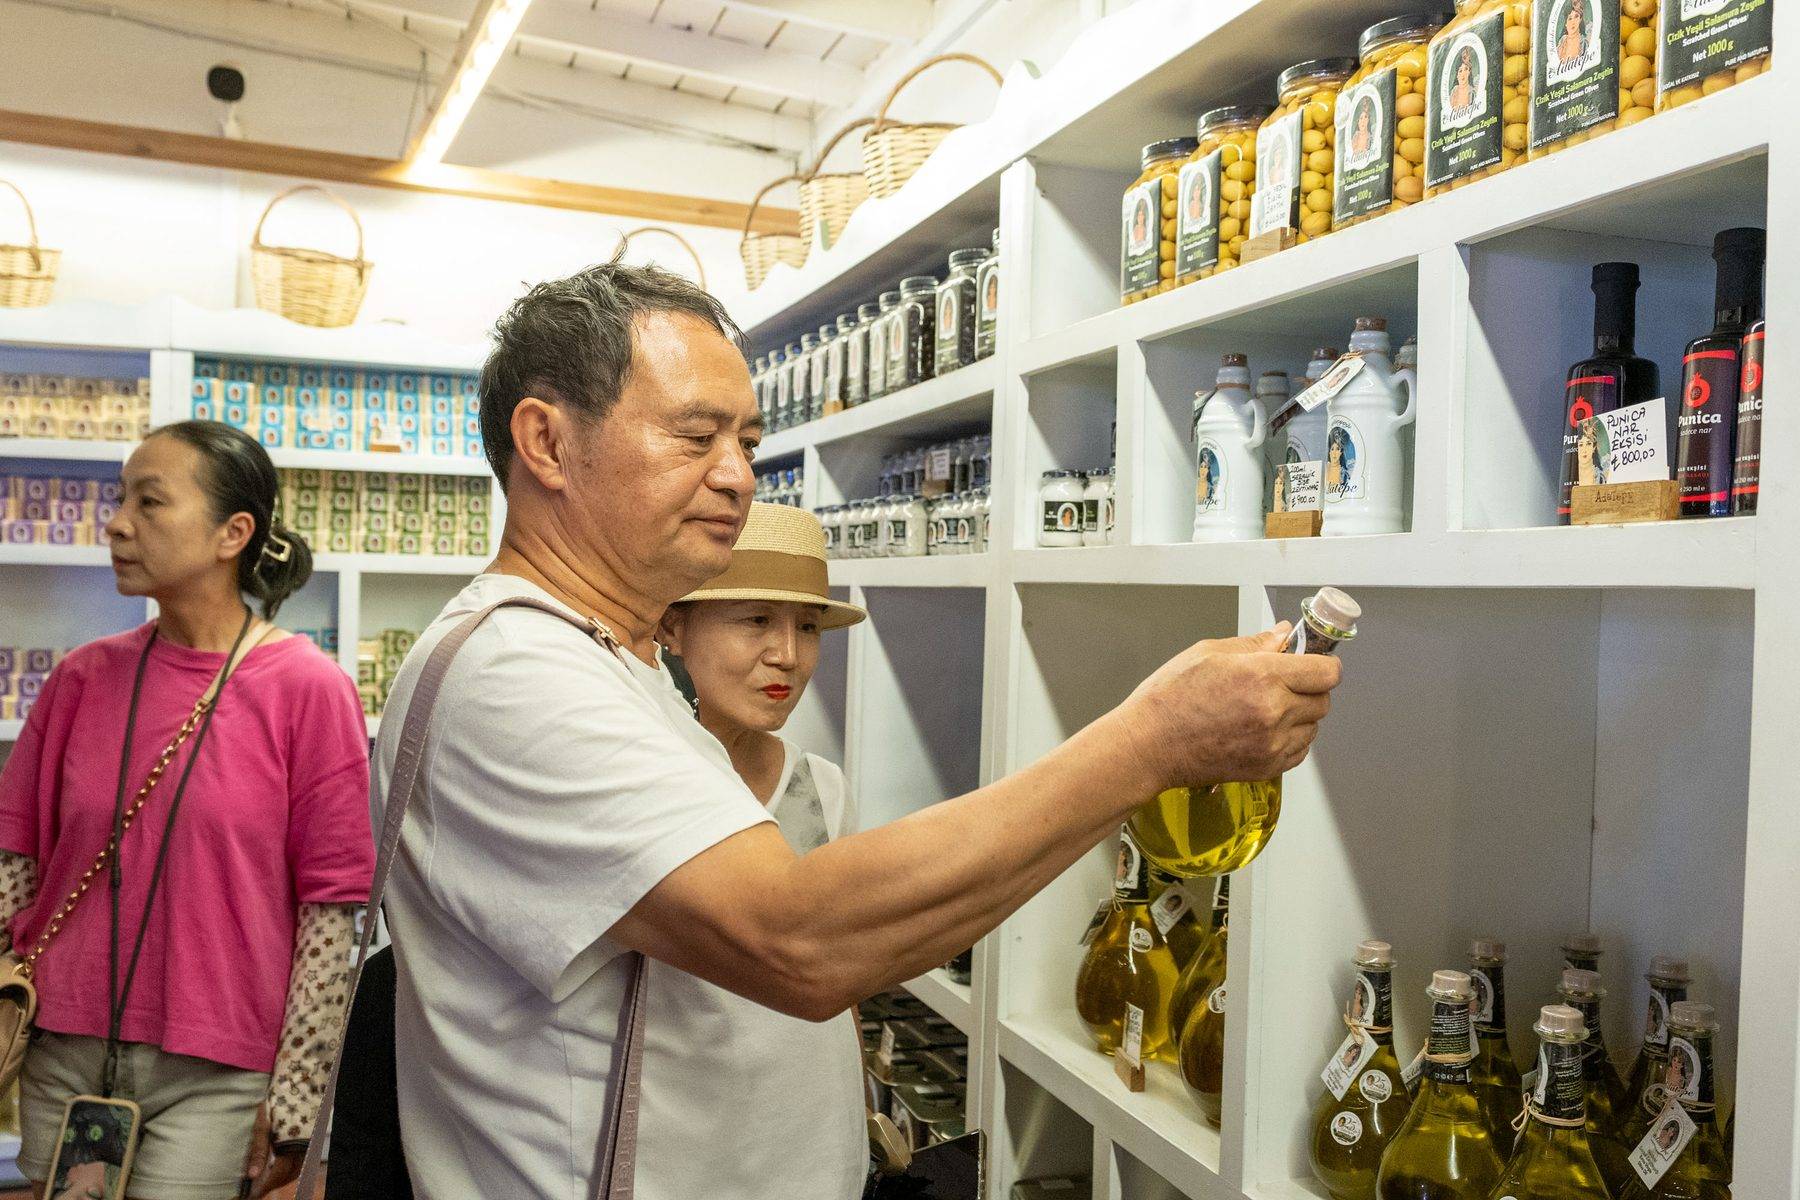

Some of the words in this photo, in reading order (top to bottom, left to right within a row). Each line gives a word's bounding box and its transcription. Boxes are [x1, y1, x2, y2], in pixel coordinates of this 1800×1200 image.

[1667, 30, 1684, 45] Çizik
[1686, 20, 1704, 35] Yeşil
[1705, 8, 1739, 28] Salamura
[1740, 0, 1765, 12] Zeytin
[1683, 30, 1710, 46] Scratched
[1710, 25, 1728, 36] Green
[1728, 15, 1748, 28] Olives
[1692, 49, 1706, 63] Net
[1708, 39, 1727, 57] 1000
[1728, 40, 1734, 51] g
[1536, 94, 1550, 107] Çizik
[1550, 87, 1564, 99] Yeşil
[1566, 76, 1592, 92] Salamura
[1594, 67, 1614, 80] Zeytin
[1570, 90, 1584, 99] Green
[1584, 84, 1600, 93] Olives
[1480, 116, 1498, 128] Zeytin
[1556, 112, 1567, 123] Net
[1568, 104, 1583, 119] 1000
[1448, 156, 1458, 166] Net
[1458, 148, 1472, 162] 1000
[1678, 411, 1721, 427] Punica
[1614, 422, 1639, 439] NAR
